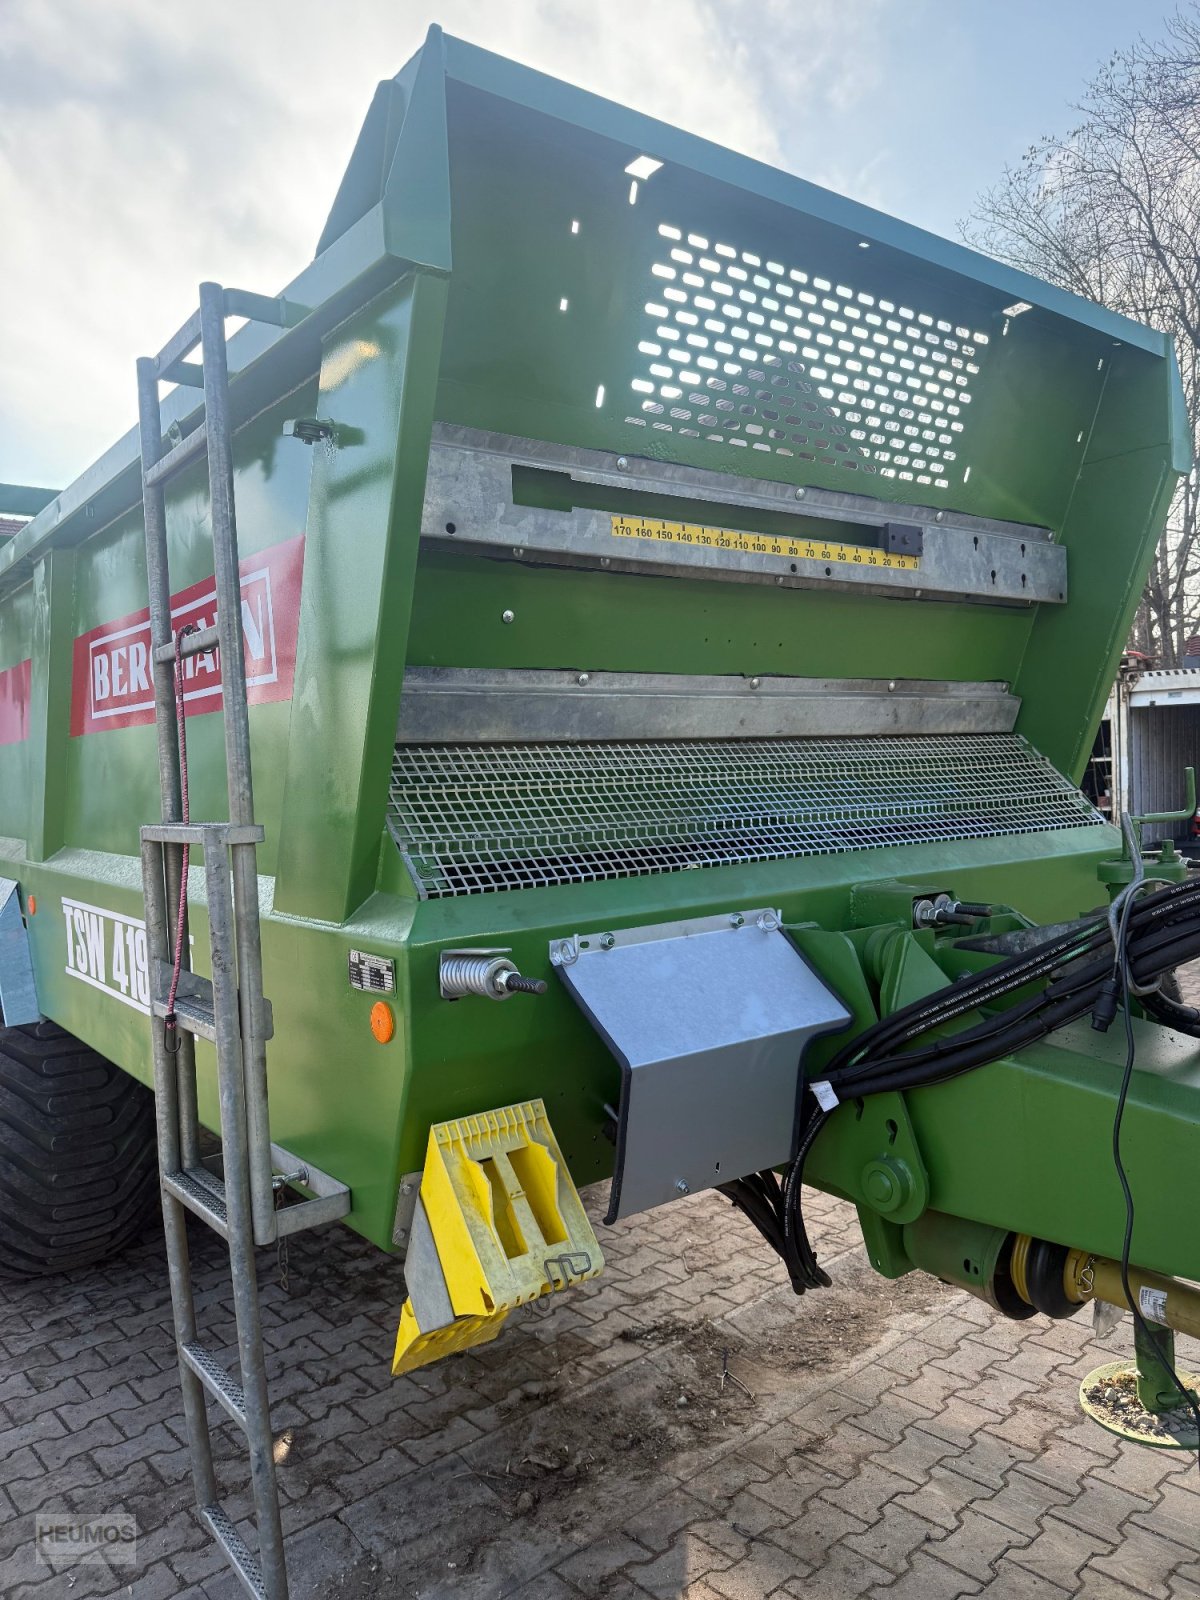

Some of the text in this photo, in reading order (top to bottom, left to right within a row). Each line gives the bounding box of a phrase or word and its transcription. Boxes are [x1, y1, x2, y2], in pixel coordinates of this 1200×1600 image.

[614, 526, 632, 535] 170
[636, 528, 652, 538] 160
[656, 530, 672, 540] 150
[676, 533, 692, 542] 140
[696, 535, 711, 544] 130
[715, 538, 730, 547] 120
[734, 541, 748, 549] 110
[752, 543, 766, 552] 100
[772, 545, 781, 553] 90
[789, 547, 798, 555] 80
[806, 549, 815, 557] 70
[838, 553, 846, 561] 50
[853, 555, 862, 563] 40
[62, 904, 106, 984] TSW
